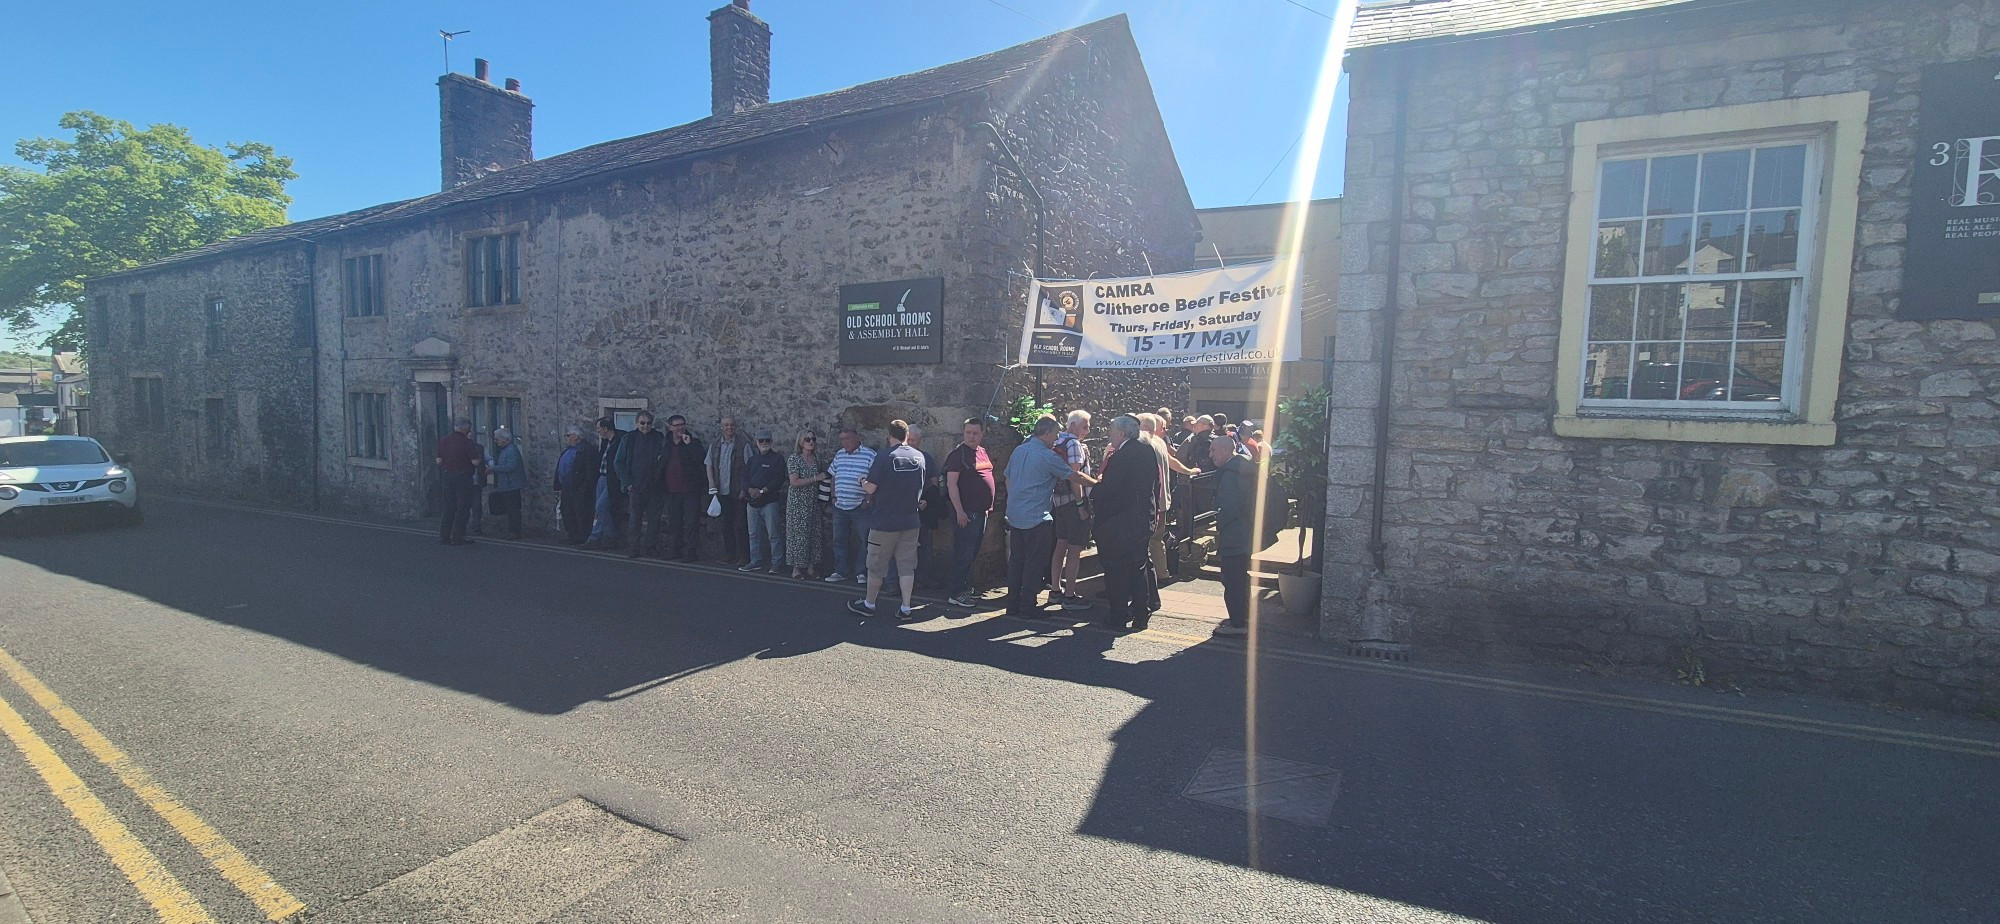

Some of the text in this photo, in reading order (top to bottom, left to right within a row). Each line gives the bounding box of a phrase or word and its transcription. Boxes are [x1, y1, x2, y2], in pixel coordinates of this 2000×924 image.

[1929, 142, 1950, 166] 3
[1095, 282, 1154, 298] CAMRA
[1094, 284, 1290, 315] Clitheroe Beer Festiva
[846, 311, 931, 328] OLD SCHOOL ROOMS
[1110, 310, 1261, 333] Thurs, Friday, Saturday
[848, 327, 929, 340] & ASSEMBLY HALL
[1133, 336, 1153, 352] 15
[1172, 332, 1196, 350] 17
[1201, 330, 1251, 349] May
[1096, 349, 1281, 366] www.clitheroebeerfestival.co.u
[1201, 366, 1273, 374] ASSEMBLY HAL
